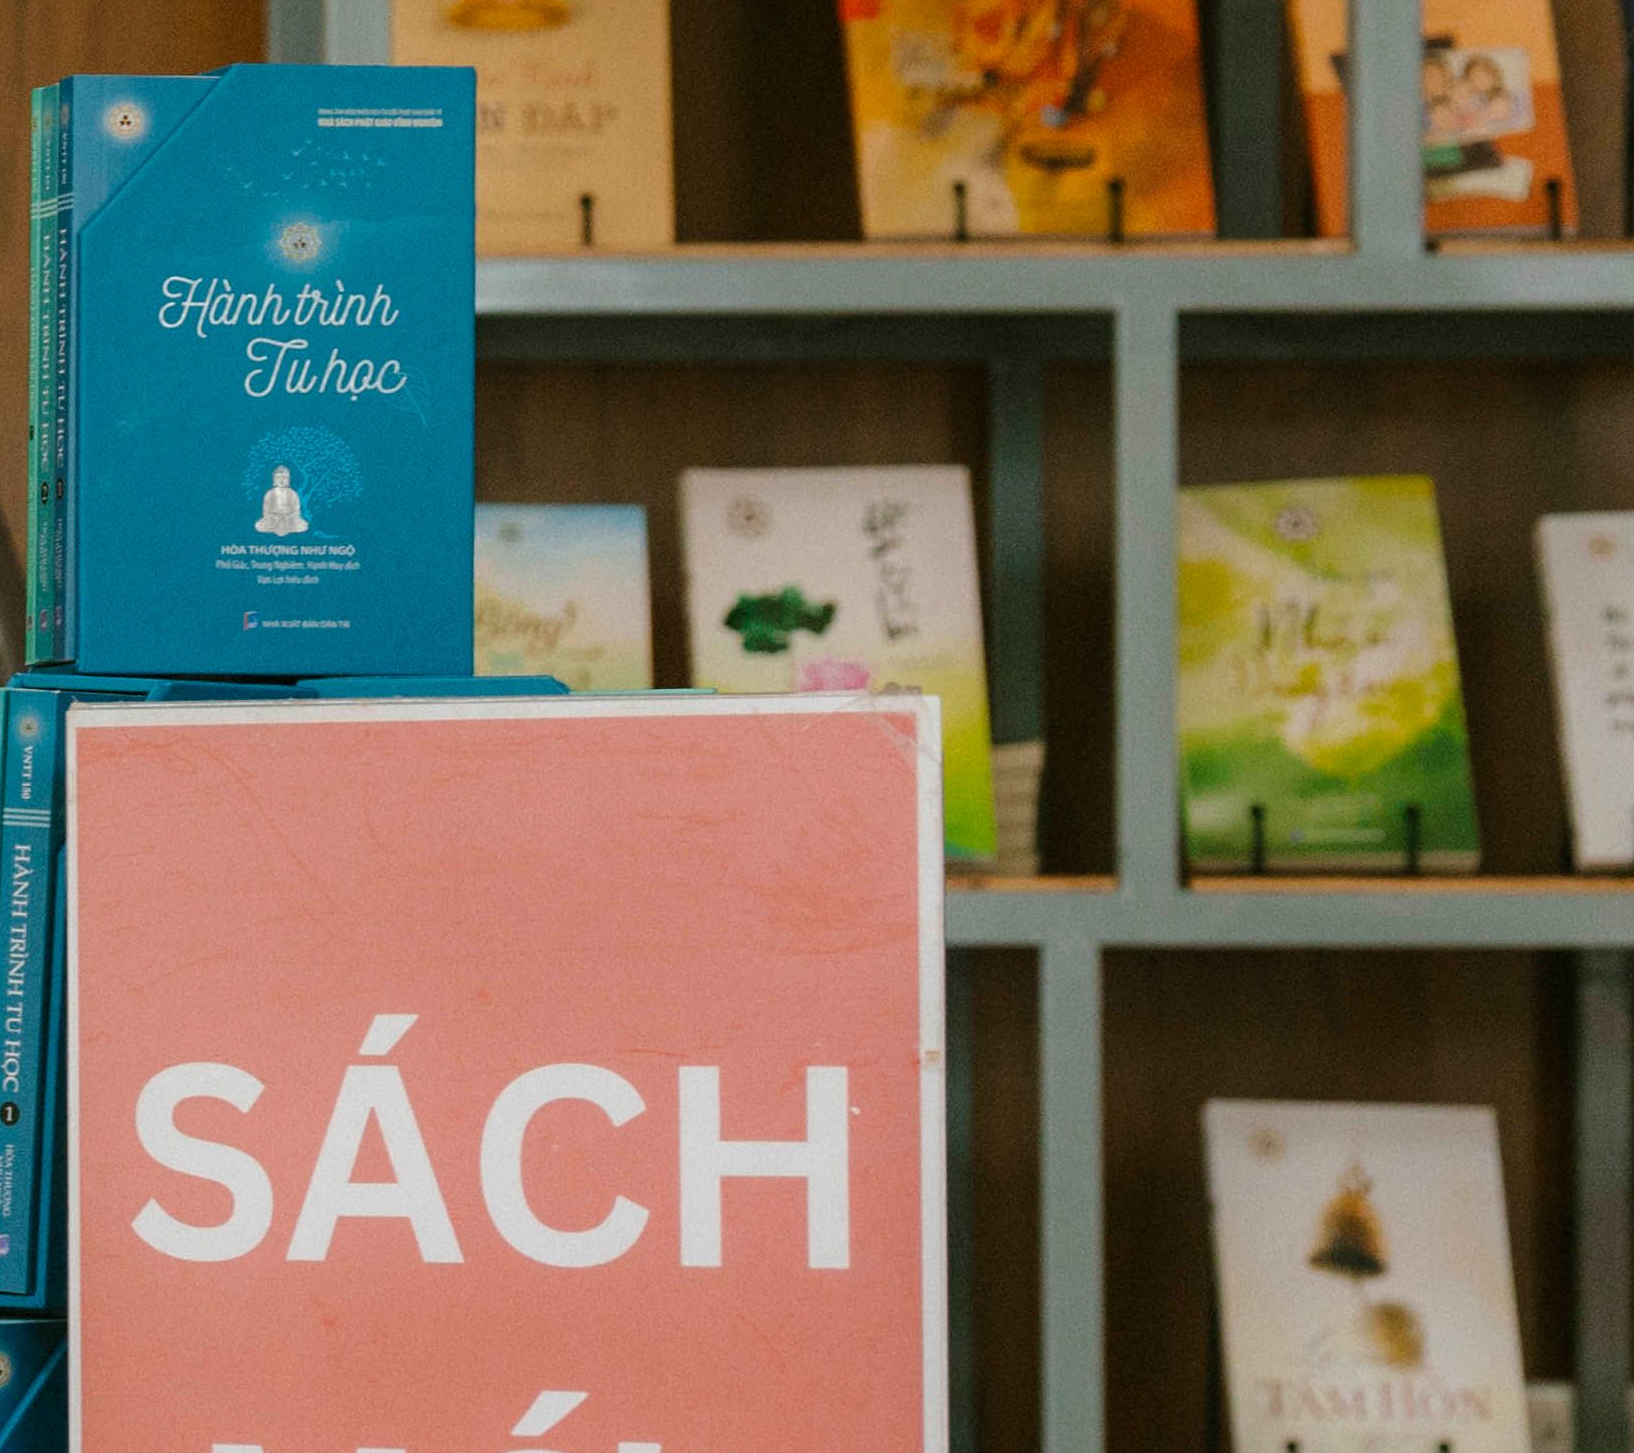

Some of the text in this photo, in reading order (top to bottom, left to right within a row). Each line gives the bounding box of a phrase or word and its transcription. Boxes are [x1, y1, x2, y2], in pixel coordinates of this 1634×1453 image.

[158, 276, 400, 338] Hành trình
[244, 338, 408, 401] Tu học
[0, 844, 34, 1122] HÀNH TRÌNH TU HỌC 1
[130, 1013, 850, 1270] SÁCH
